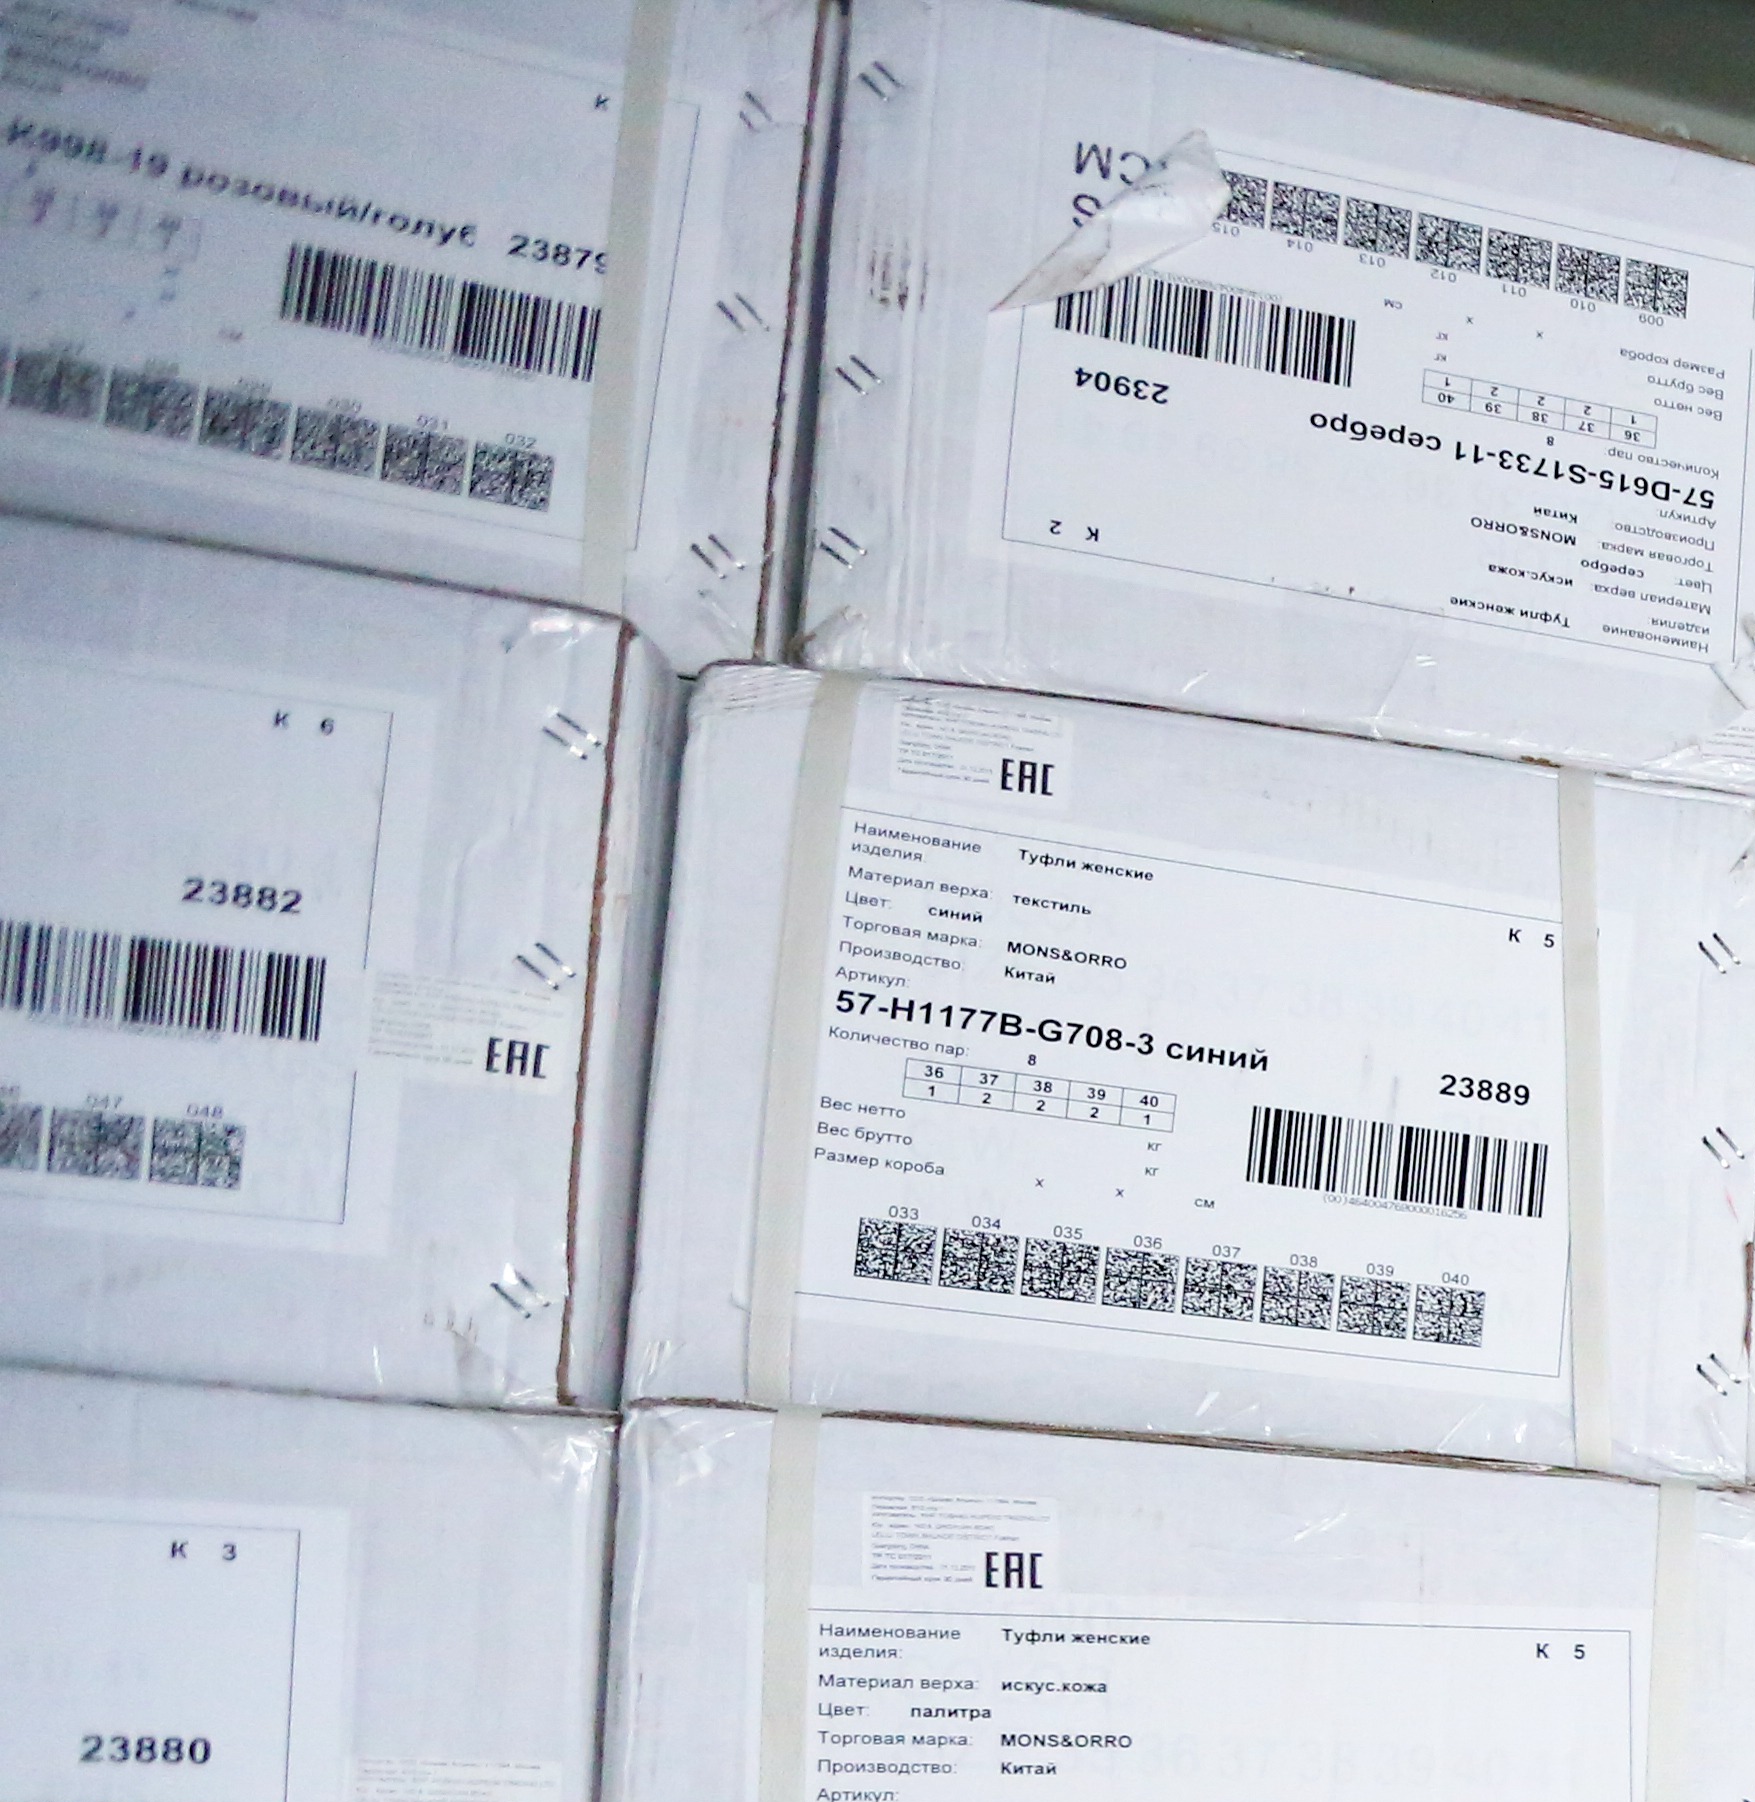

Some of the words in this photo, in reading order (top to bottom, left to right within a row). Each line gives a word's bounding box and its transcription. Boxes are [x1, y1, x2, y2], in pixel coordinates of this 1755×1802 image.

[1074, 366, 1170, 405] 23904
[1309, 412, 1442, 452] серебро
[1453, 439, 1716, 510] 57-D615-S1733-11
[1636, 454, 1720, 481] Количество
[1533, 506, 1578, 525] Китай
[1049, 519, 1063, 536] 2
[1470, 515, 1578, 547] MONS&ORRO
[1598, 541, 1645, 558] марка:
[1579, 558, 1645, 579] серебро
[1648, 550, 1714, 573] Торговая
[1487, 563, 1574, 587] искус.кожа
[1591, 583, 1636, 599] верха:
[1449, 596, 1516, 616] женские
[1639, 592, 1712, 616] Материал
[1519, 608, 1571, 629] Туфли
[1601, 624, 1710, 654] Наименование
[319, 717, 335, 736] 6
[850, 842, 926, 863] изделия:
[852, 822, 983, 855] Наименование
[1018, 848, 1077, 869] Туфли
[1080, 861, 1154, 882] женские
[181, 877, 303, 915] 23882
[847, 864, 935, 891] Материал
[939, 882, 993, 899] верха:
[1012, 894, 1092, 915] текстиль
[844, 890, 892, 908] Цвет:
[927, 906, 983, 924] синий
[842, 914, 922, 939] Торговая
[926, 930, 982, 948] марка:
[1006, 940, 1128, 970] MONS&ORRO
[1543, 933, 1555, 949] 5
[838, 939, 965, 971] Производство:
[1004, 965, 1056, 985] Китай
[834, 965, 910, 989] Артикул:
[835, 989, 1154, 1058] 57-H1177B-G708-3
[1165, 1042, 1269, 1072] синий
[828, 1025, 930, 1052] Количество
[934, 1042, 969, 1059] пар:
[1026, 1053, 1037, 1067] 8
[1438, 1073, 1531, 1107] 23889
[887, 1204, 920, 1221] 033
[1441, 1271, 1470, 1287] 040
[221, 1542, 238, 1562] 3
[819, 1623, 962, 1641] Наименование
[1001, 1627, 1066, 1646] Туфли
[1071, 1633, 1151, 1646] женские
[818, 1646, 903, 1661] изделия:
[1573, 1643, 1586, 1660] 5
[818, 1673, 914, 1692] Материал
[919, 1678, 980, 1693] верха:
[1001, 1680, 1108, 1696] искус.кожа
[817, 1702, 869, 1720] Цвет:
[910, 1707, 992, 1722] палитра
[79, 1734, 212, 1765] 23880
[816, 1730, 906, 1748] Торговая
[911, 1734, 973, 1749] марка:
[1000, 1733, 1133, 1749] MONS&ORRO
[816, 1758, 957, 1777] Производство:
[1000, 1761, 1057, 1776] Китай
